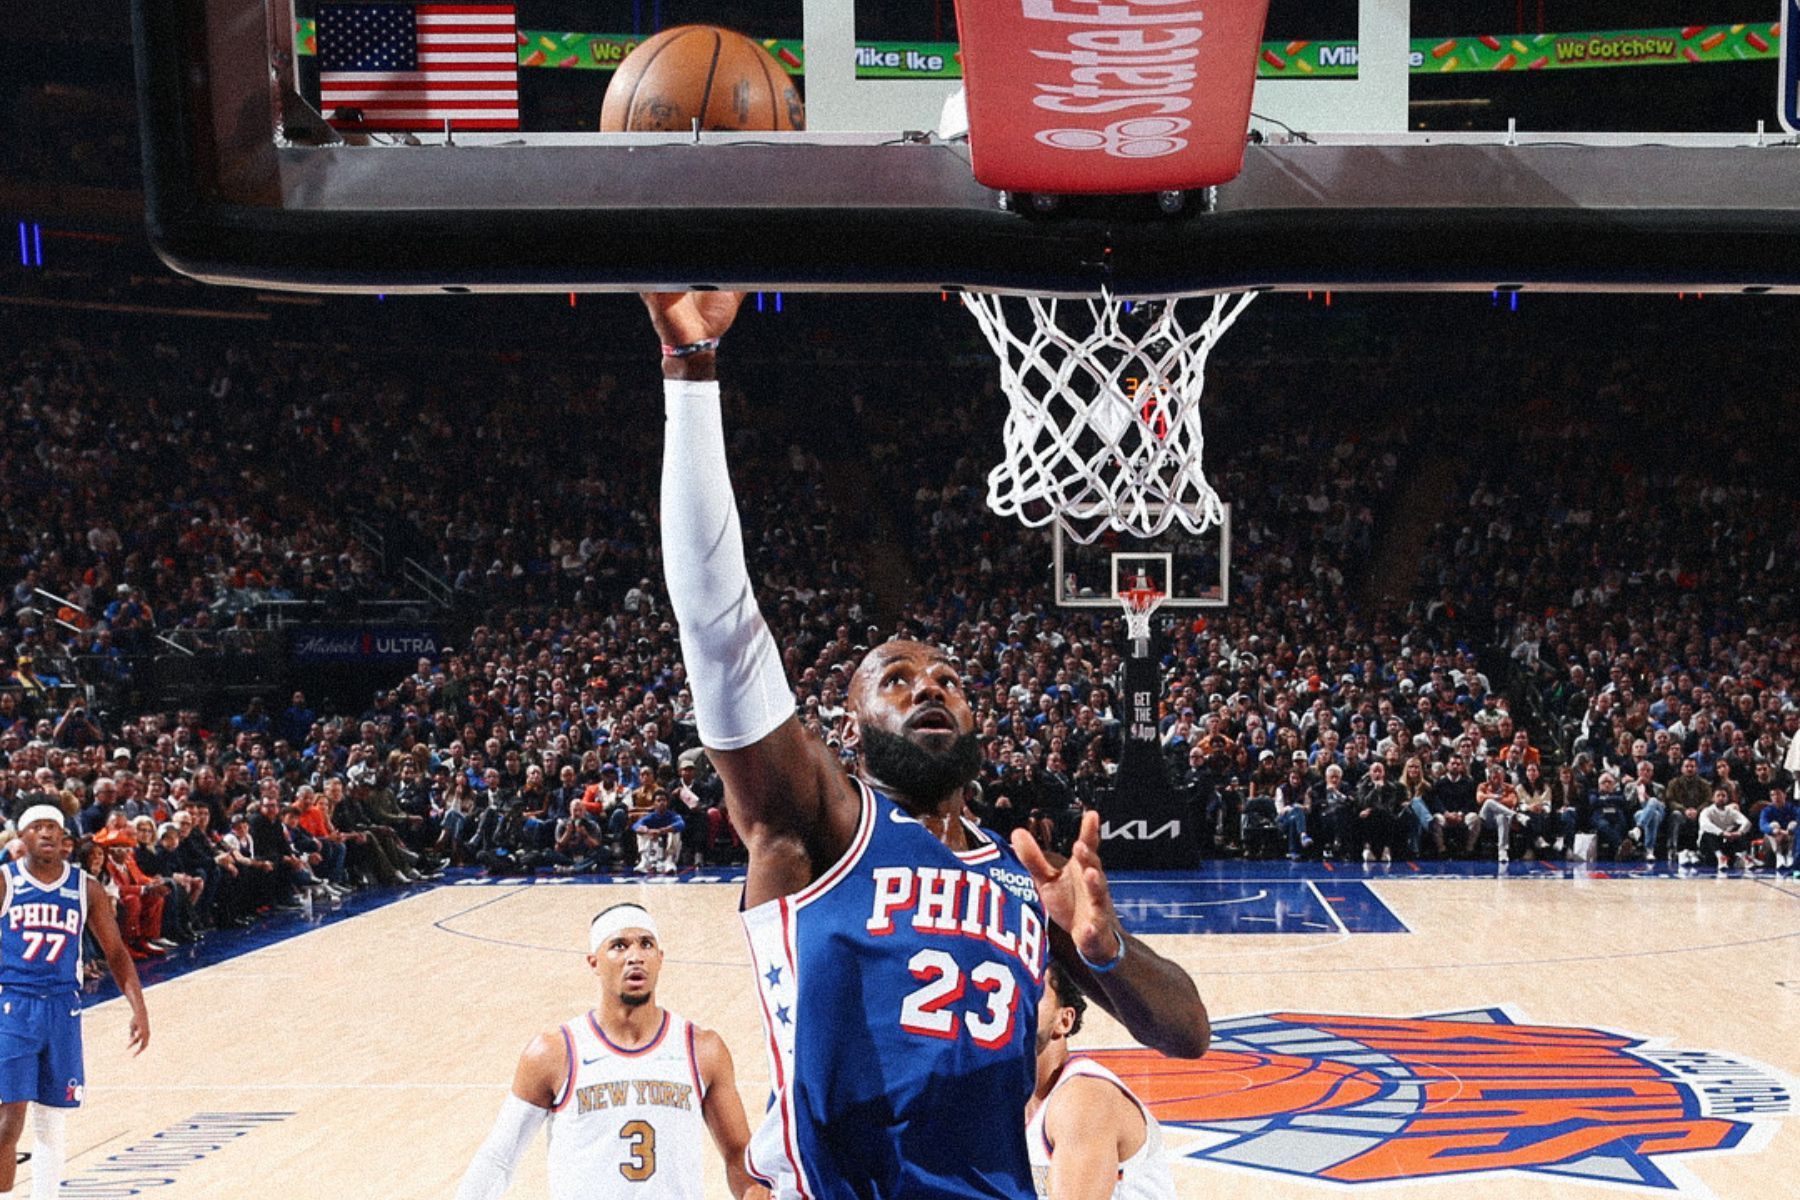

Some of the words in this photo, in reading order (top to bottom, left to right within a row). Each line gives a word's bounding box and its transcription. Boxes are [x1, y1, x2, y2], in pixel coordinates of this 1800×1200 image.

[592, 43, 622, 61] We
[906, 51, 943, 70] Ike
[1320, 46, 1359, 66] Mik
[1556, 42, 1585, 59] We
[1029, 27, 1203, 114] State
[376, 638, 437, 653] ULTRA
[1134, 691, 1152, 707] GET
[1134, 707, 1153, 722] THE
[1100, 820, 1181, 840] KIA
[9, 903, 80, 936] PHILA
[866, 866, 1048, 985] PHILA
[22, 930, 68, 964] 77
[900, 948, 1021, 1050] 23
[576, 1082, 631, 1116] NEW
[632, 1080, 693, 1111] YORK
[619, 1119, 656, 1182] 3
